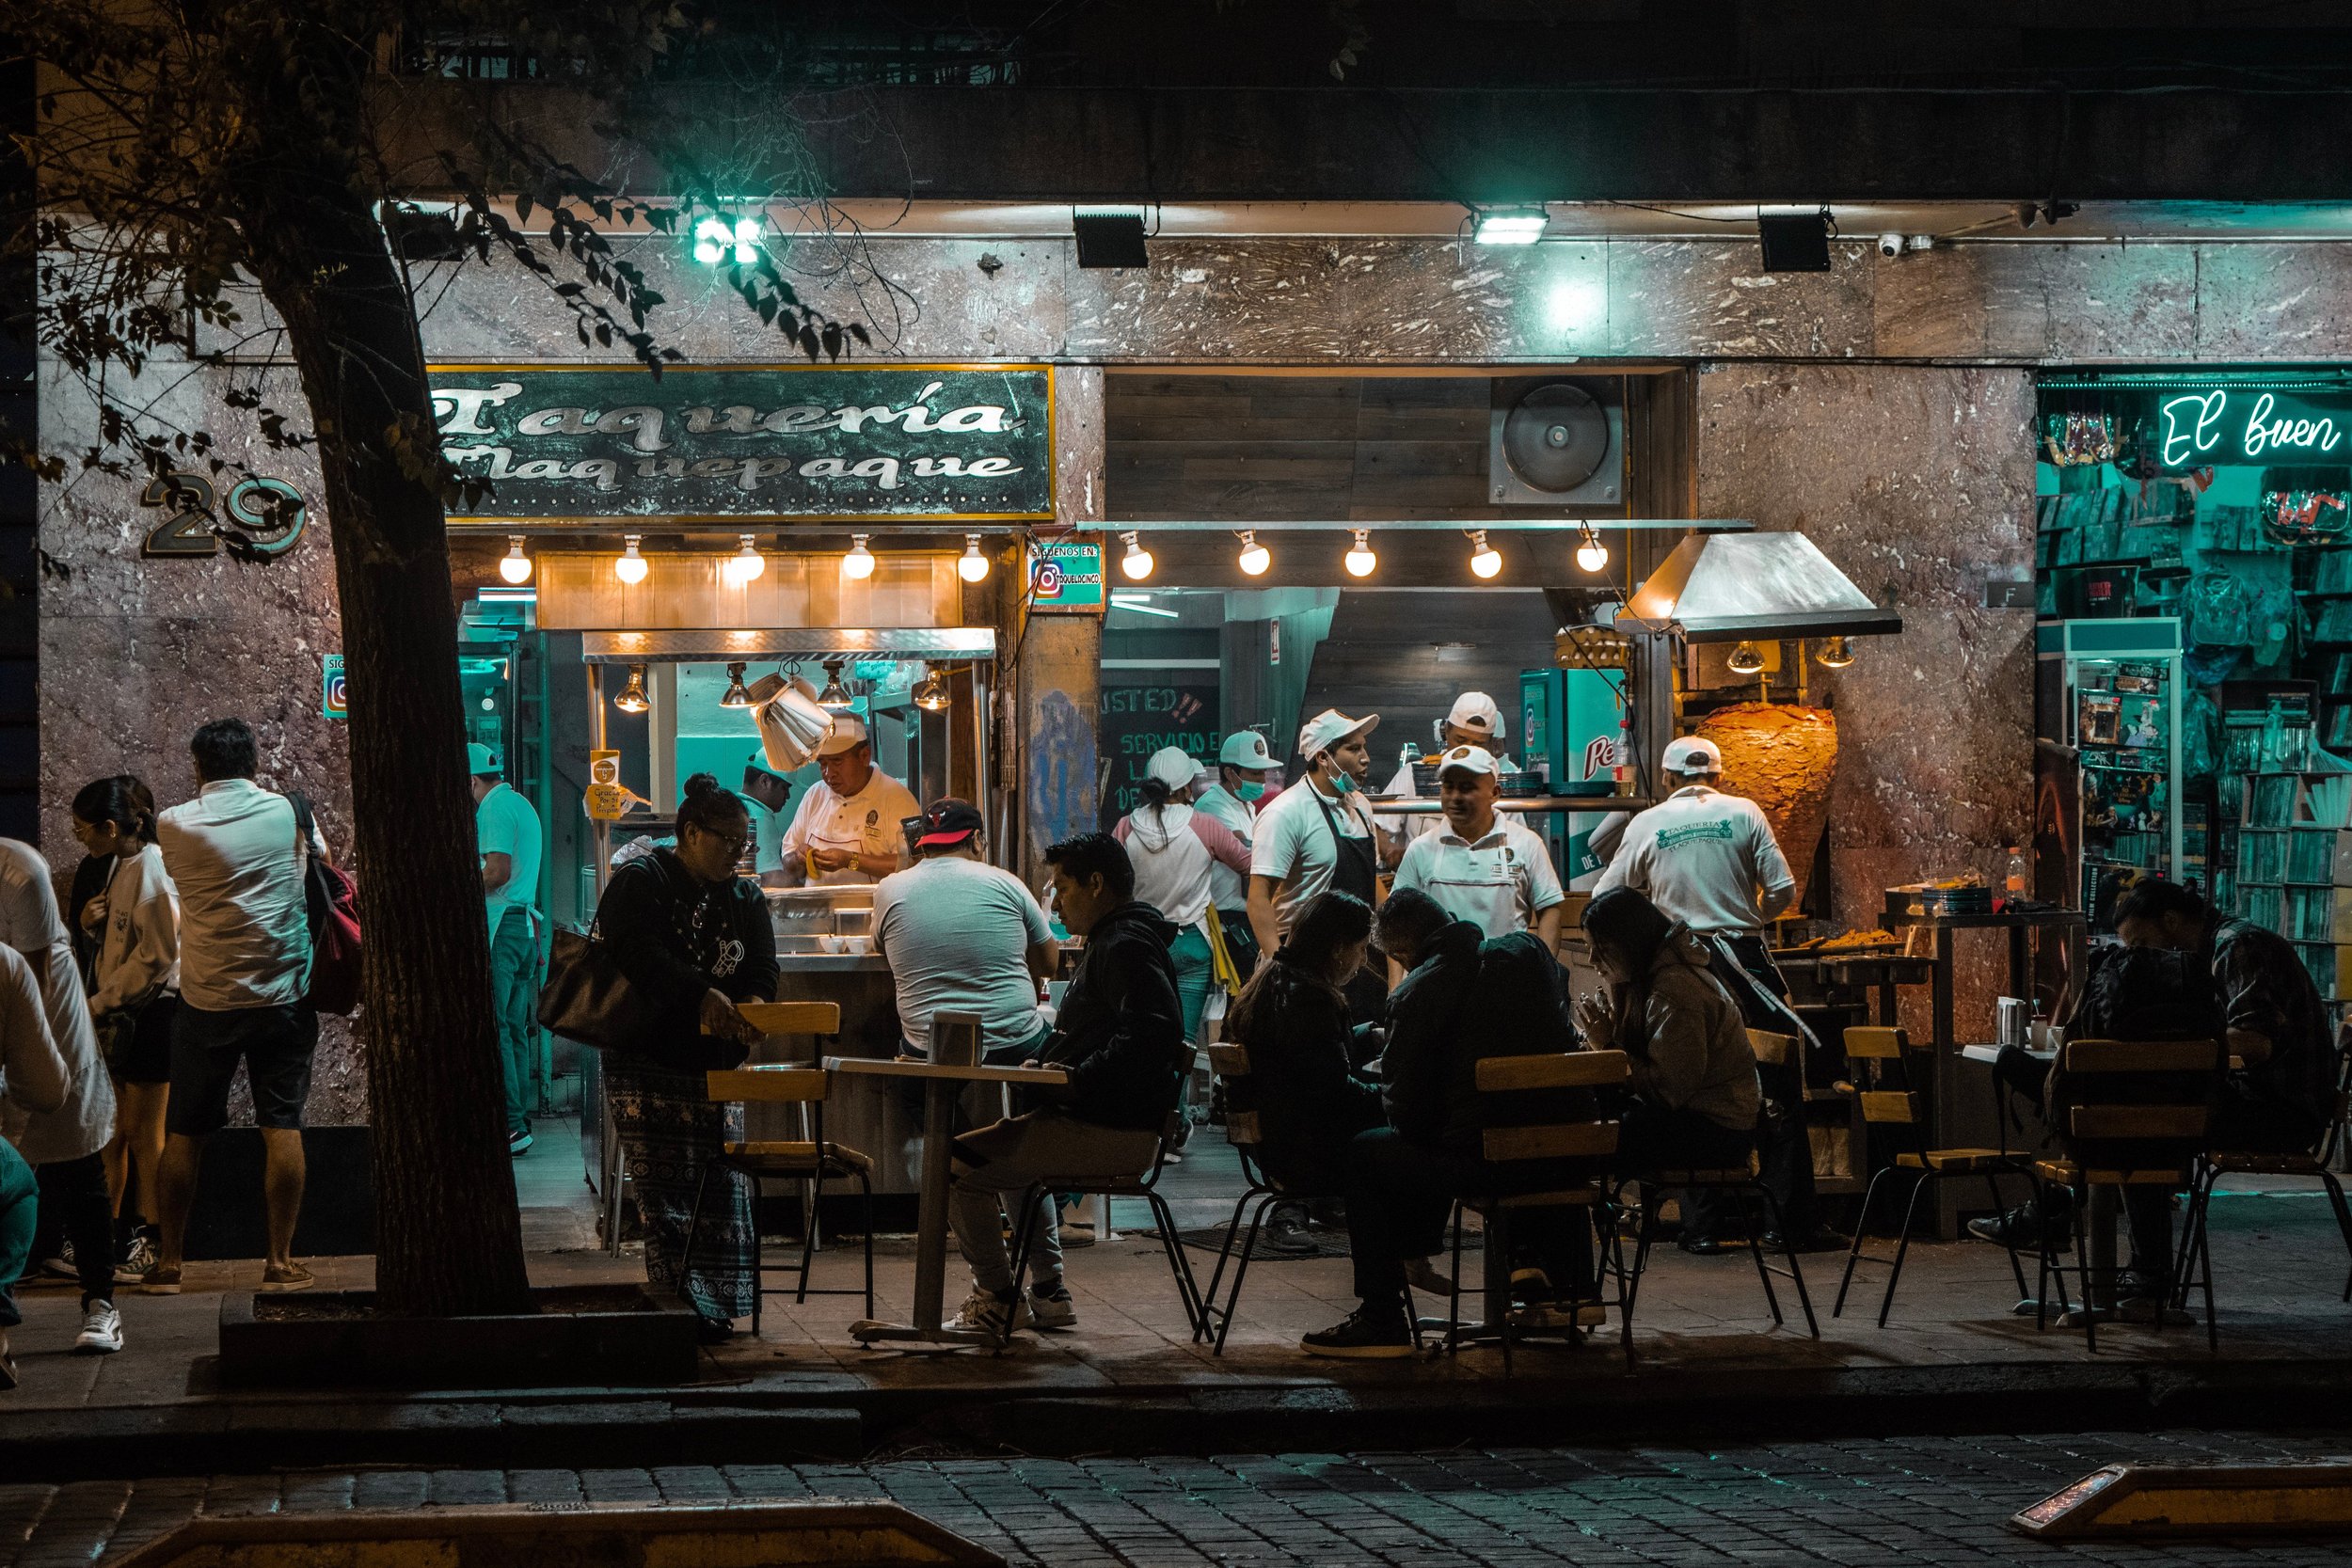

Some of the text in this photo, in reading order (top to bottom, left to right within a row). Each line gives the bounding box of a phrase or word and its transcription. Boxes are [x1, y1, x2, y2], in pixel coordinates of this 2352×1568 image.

[430, 380, 1025, 452] Taquería
[2163, 389, 2227, 466] El
[141, 473, 308, 558] 29
[1081, 546, 1098, 557] EN:
[1120, 731, 1221, 754] SERVICIO E
[1581, 854, 1596, 871] DE
